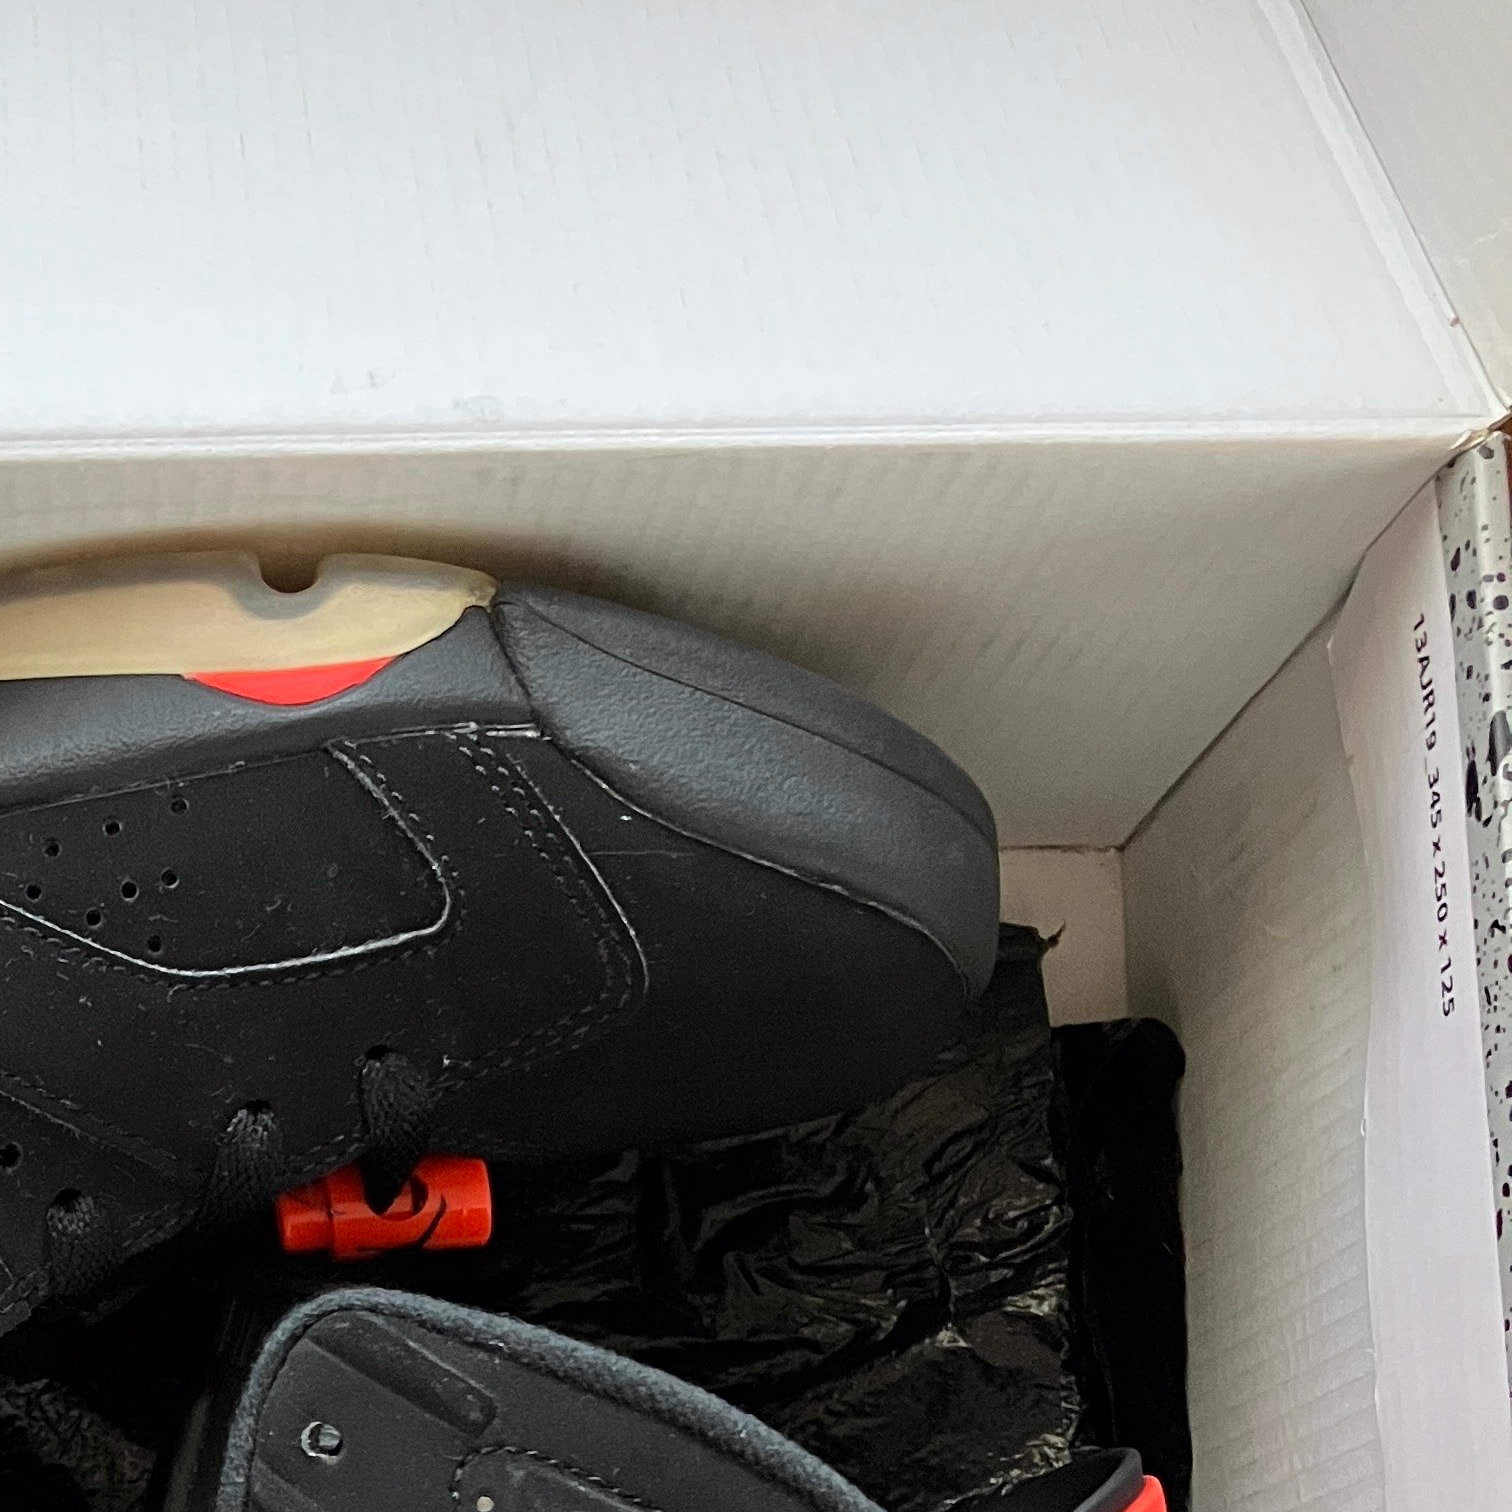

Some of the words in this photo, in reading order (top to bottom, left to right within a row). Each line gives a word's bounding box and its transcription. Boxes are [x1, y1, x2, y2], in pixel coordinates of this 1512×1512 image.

[1431, 835, 1442, 859] x
[1433, 861, 1449, 923] 250
[1437, 929, 1449, 952] x
[1439, 956, 1455, 1018] 125
